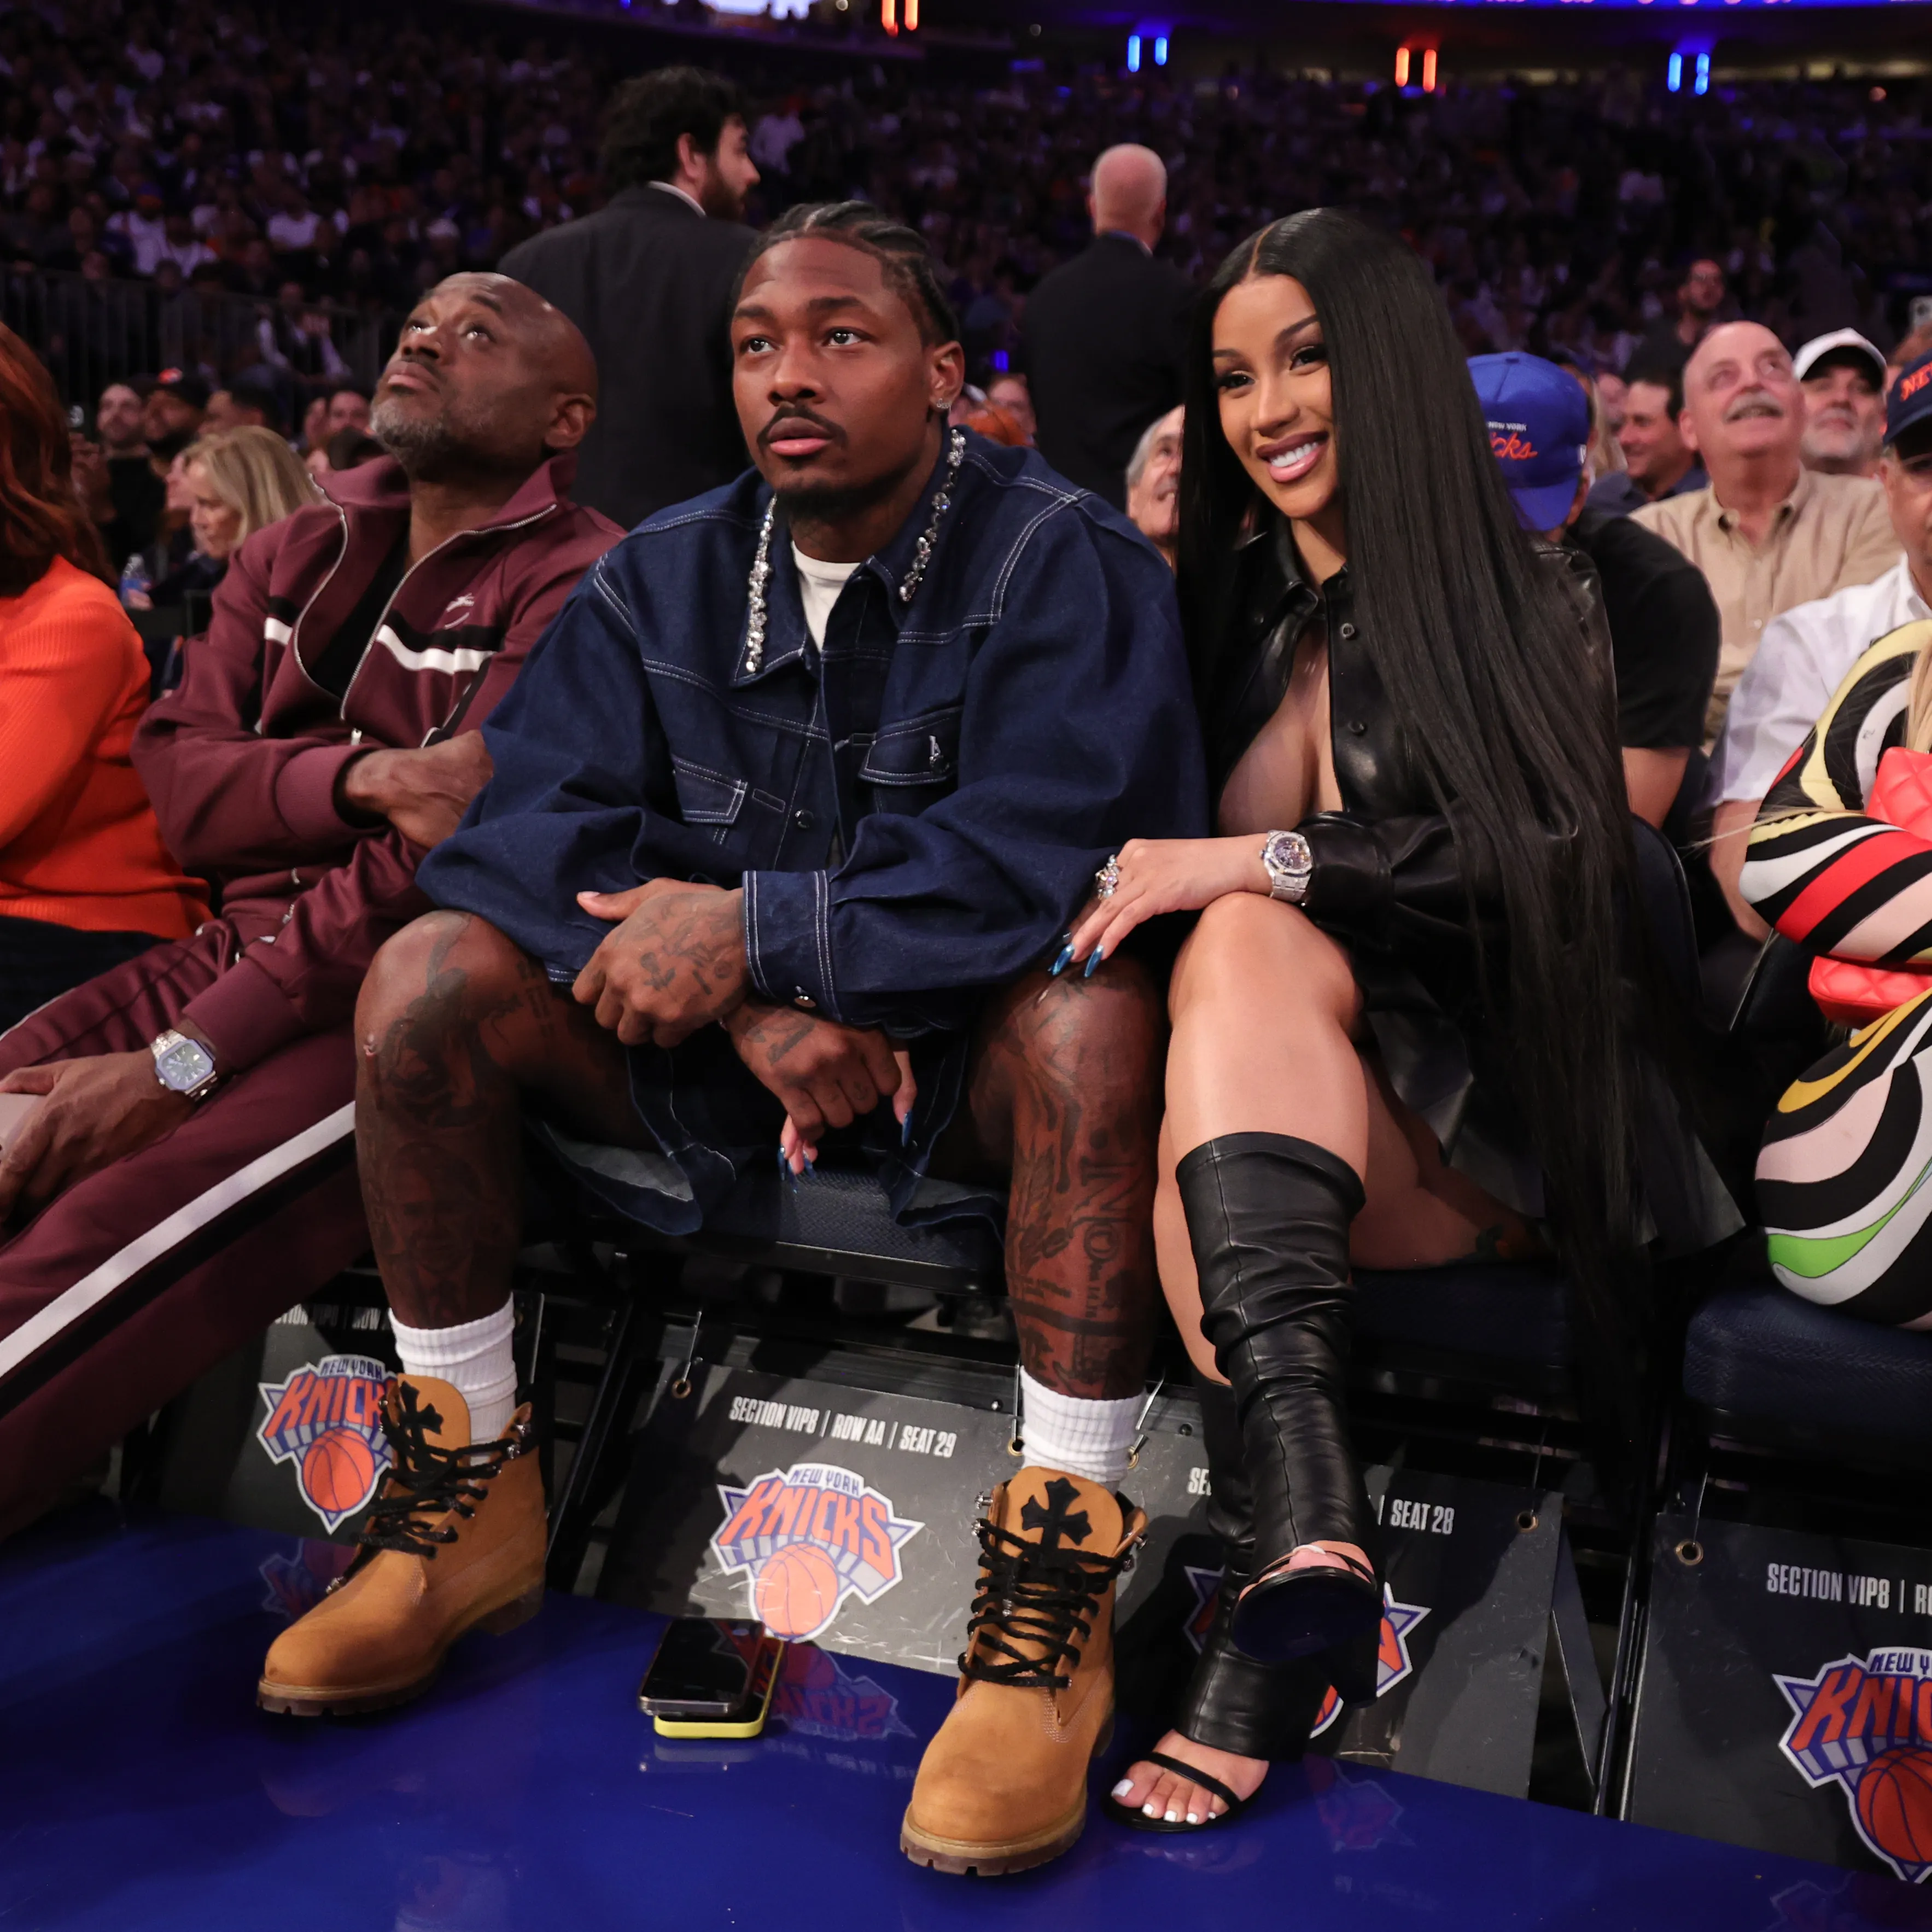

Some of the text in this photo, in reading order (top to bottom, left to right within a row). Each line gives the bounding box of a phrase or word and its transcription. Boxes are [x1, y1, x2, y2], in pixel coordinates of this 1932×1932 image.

[1506, 422, 1527, 432] YORK
[320, 1359, 382, 1380] NEW YORK
[264, 1371, 386, 1438] KNICK
[729, 1396, 958, 1459] SECTION VIP8 ROW AA SEAT 29
[789, 1468, 860, 1496] NEW YORK
[718, 1477, 896, 1581] KNICKS
[1390, 1498, 1455, 1535] SEAT 28
[1766, 1562, 1843, 1602] SECTION
[1847, 1574, 1890, 1609] VIP8
[1870, 1652, 1914, 1673] NEW
